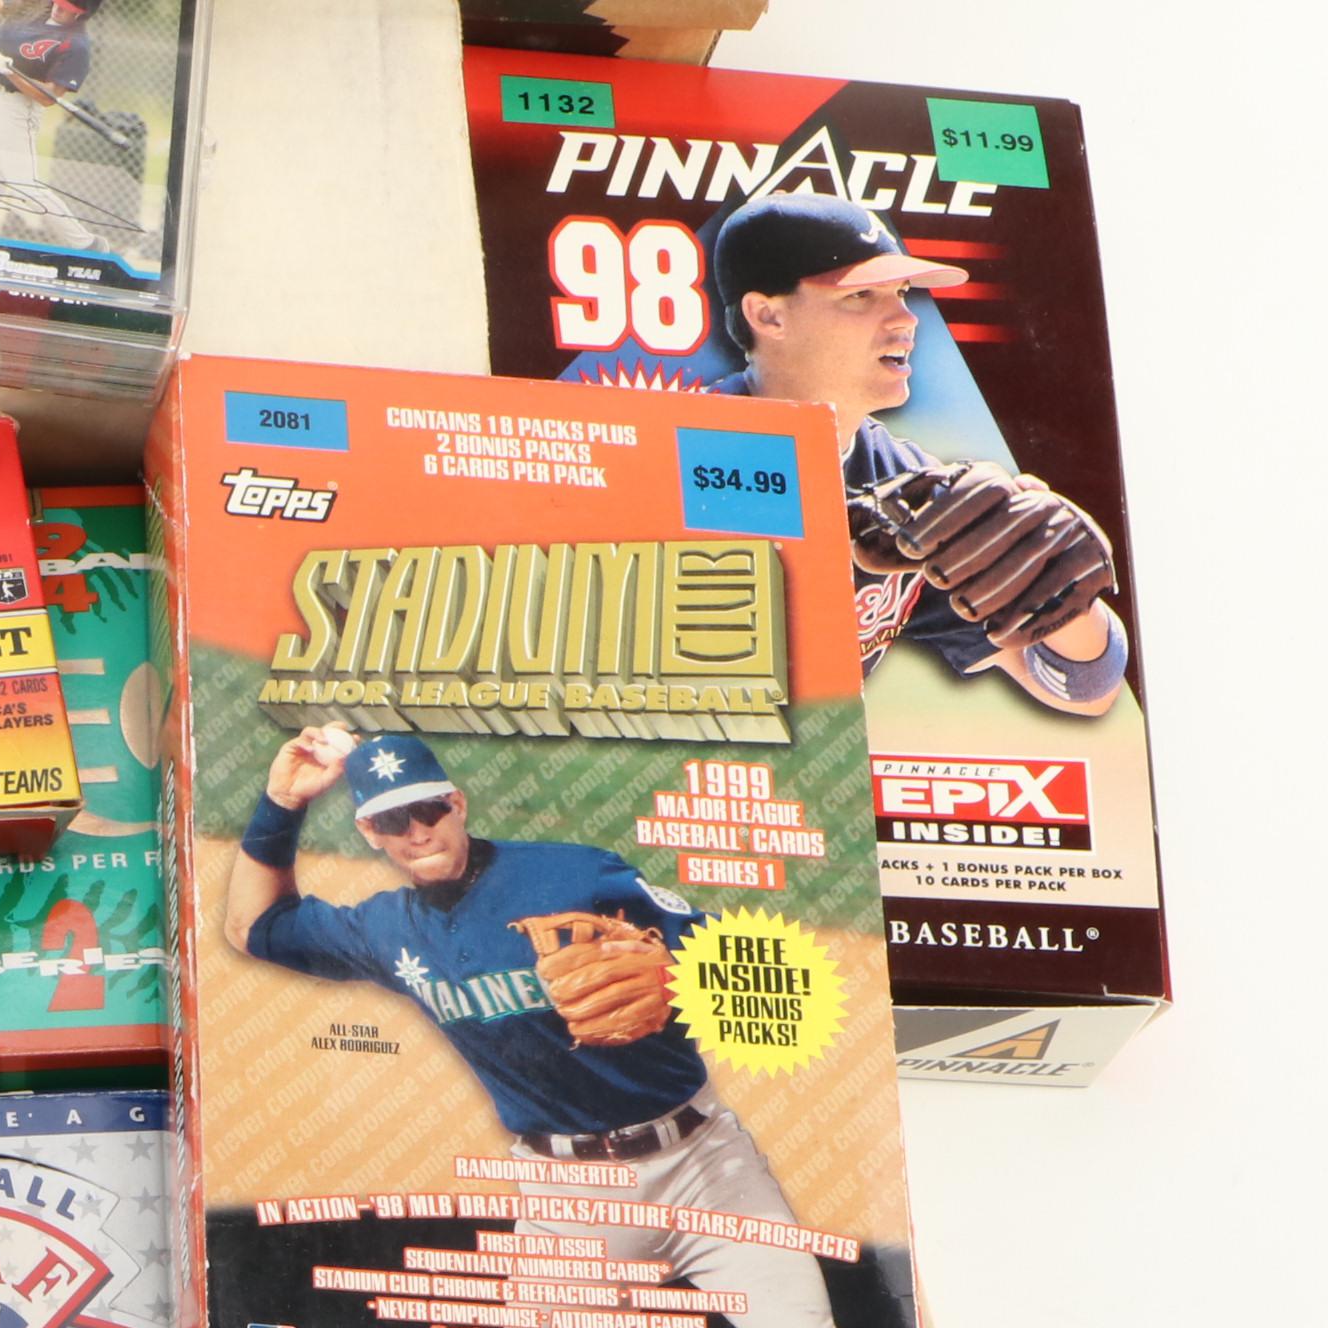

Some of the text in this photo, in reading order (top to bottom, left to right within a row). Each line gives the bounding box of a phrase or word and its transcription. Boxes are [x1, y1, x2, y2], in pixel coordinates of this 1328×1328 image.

[518, 91, 596, 115] 1132
[941, 127, 1035, 153] $11.99
[548, 215, 710, 356] 98
[259, 409, 311, 432] 2081
[386, 406, 637, 446] CONTAINS 18 PACKS PLUS
[437, 433, 591, 464] 2 BONUS PACKS
[424, 454, 607, 487] 6 CARDS PER PACK
[692, 465, 786, 496] $34.99
[271, 541, 660, 677] STADIUM
[12, 678, 48, 695] CARDS
[259, 679, 549, 710] MAJOR LEAGUE
[685, 762, 771, 799] 1999
[884, 763, 997, 778] PINNACLE
[881, 765, 1086, 820] EPIX
[656, 794, 802, 826] MAJOR LEAGUE
[752, 829, 824, 856] CARDS
[892, 821, 1061, 846] INSIDE!
[73, 853, 128, 869] PER
[688, 858, 775, 886] SERIES 1
[957, 863, 1123, 880] BONUS PACK PER BOX
[916, 875, 1067, 892] 10 CARDS PER PACK
[719, 934, 788, 966] FREE
[699, 962, 810, 996] INSIDE!
[712, 995, 802, 1021] 2 BONUS
[330, 1024, 378, 1038] ALL-STAR
[719, 1020, 798, 1046] PACKS!
[311, 1037, 400, 1055] ALEX RODRIGUEZ
[456, 1158, 636, 1186] RANDOMLY INSERTED:
[258, 1194, 858, 1260] IN MLB DRAFT PICKS/FUTURE STARS/PROSPECTS
[479, 1234, 605, 1258] FIRST DAY ISSUE
[405, 1250, 602, 1280] SEQUENTIALLY NUMBERED
[314, 1268, 747, 1313] STADIUM CLUB CHROME REFRACTORS TRIUMVIRATES
[430, 1303, 538, 1328] COMPROMISE
